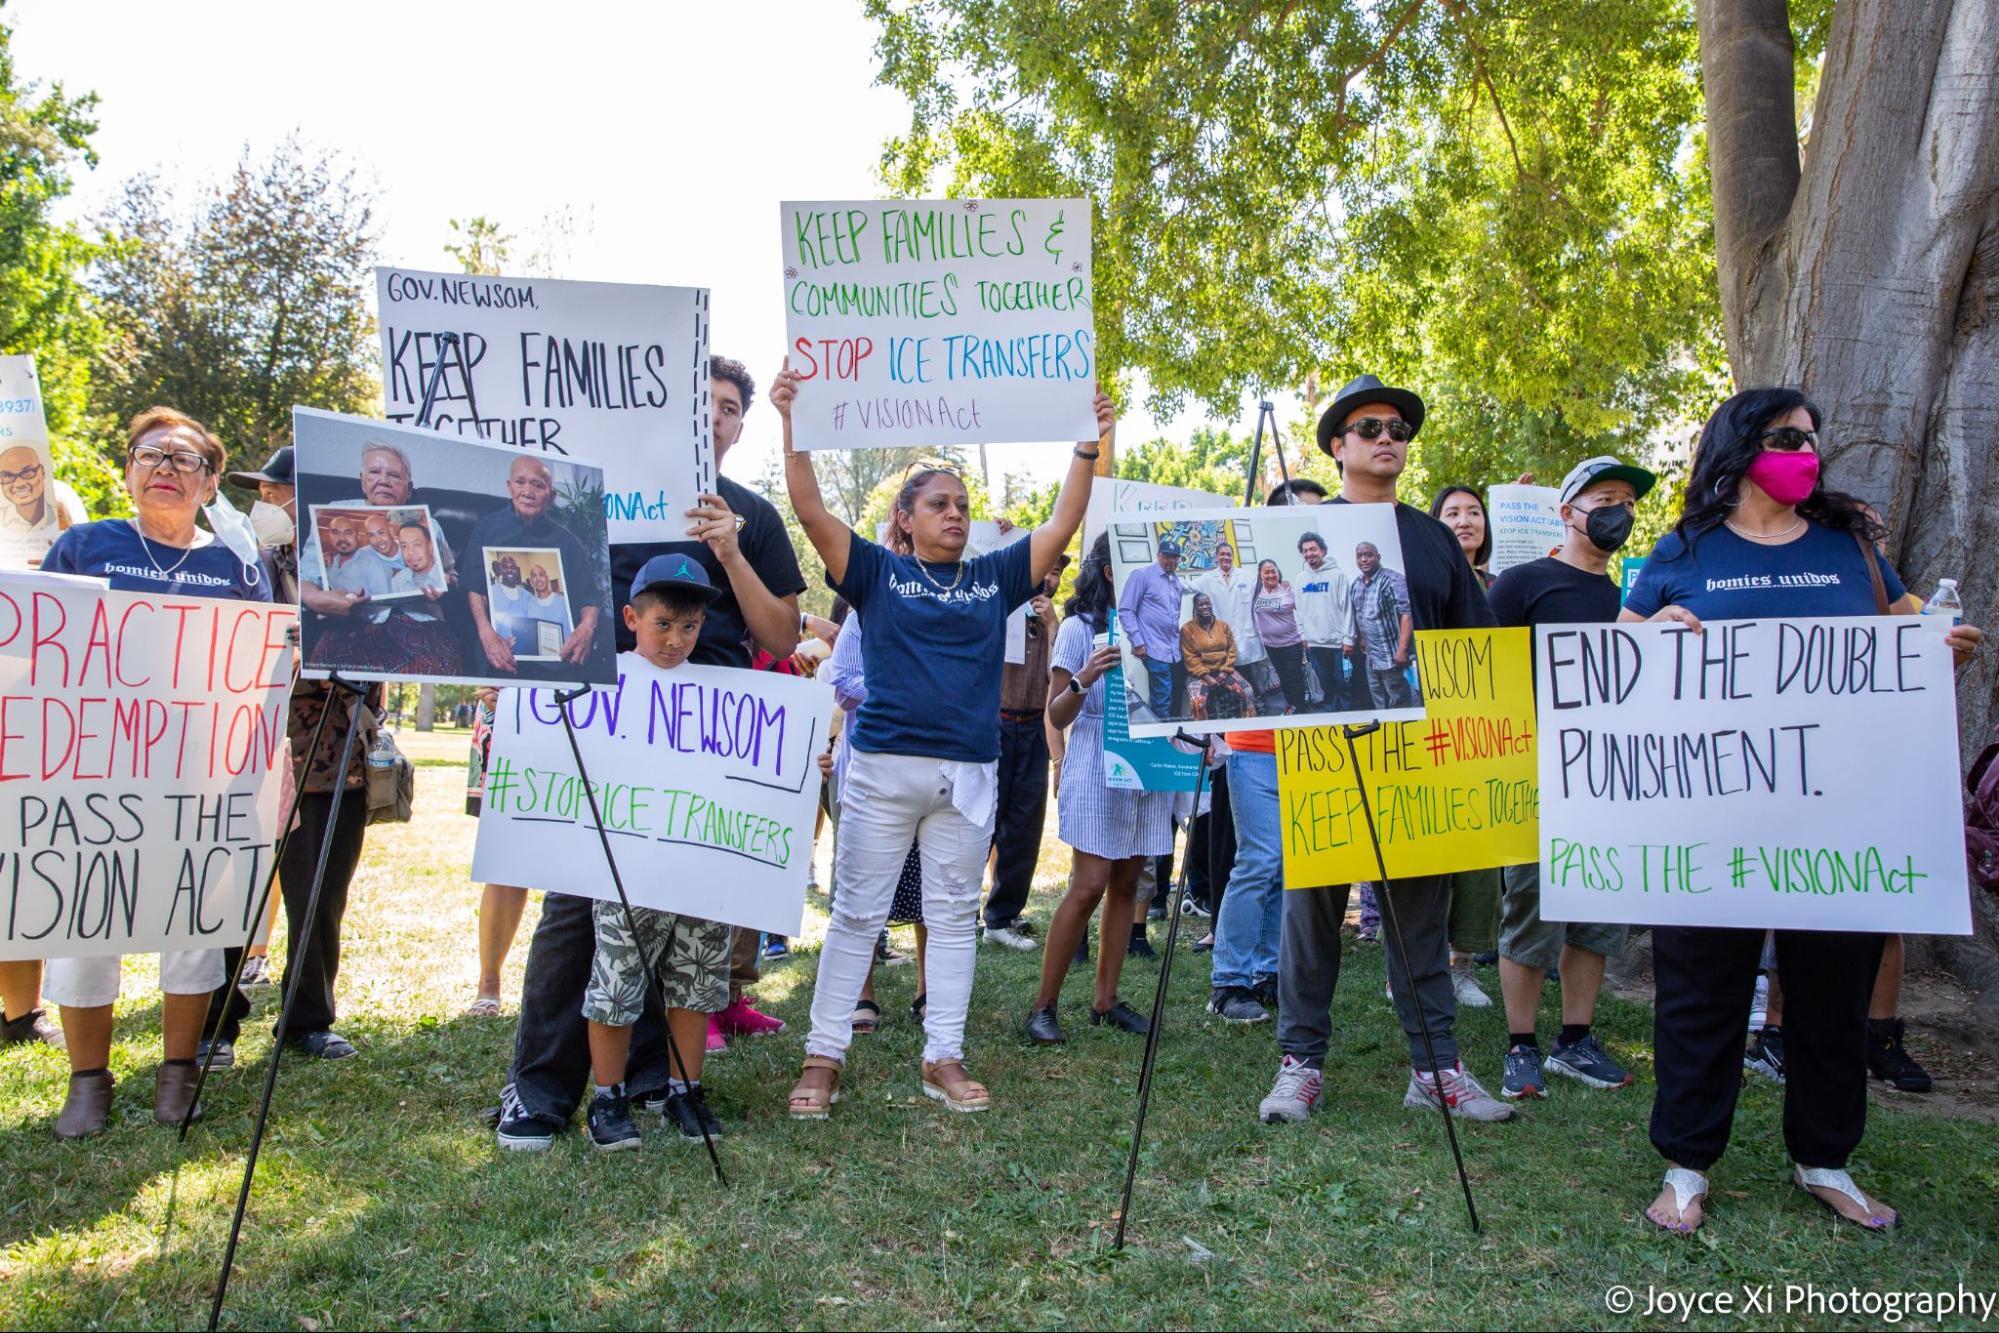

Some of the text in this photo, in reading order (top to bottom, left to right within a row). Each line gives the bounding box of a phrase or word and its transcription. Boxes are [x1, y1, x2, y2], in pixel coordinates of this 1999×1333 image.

[795, 208, 1065, 269] KEEP FAMILIES &
[790, 272, 1095, 319] COMMUNITIES TOGETHER
[389, 326, 668, 409] KEEP FAMILIES
[794, 329, 1090, 384] STOP ICE TRANSFERS
[603, 490, 668, 521] ONAct
[1500, 502, 1539, 511] PASS THE
[1500, 515, 1529, 524] VISION
[1706, 572, 1840, 592] homies unidos
[1416, 634, 1495, 701] WSOM
[1547, 622, 1927, 710] END THE DOUBLE
[0, 696, 281, 781] EDEMPTION
[648, 679, 786, 776] NEWSOM
[1280, 715, 1533, 775] PASS THE #VISIONAct
[1559, 723, 1824, 801] PUNISHMENT.
[20, 792, 254, 846] PASS THE
[602, 782, 655, 832] ICE
[664, 788, 793, 865] TRANSFERS
[1289, 777, 1540, 856] KEEP FAMILIES TOGETHE
[0, 844, 271, 941] ISION ACT
[1549, 837, 1929, 896] PASS THE #VISIONAct
